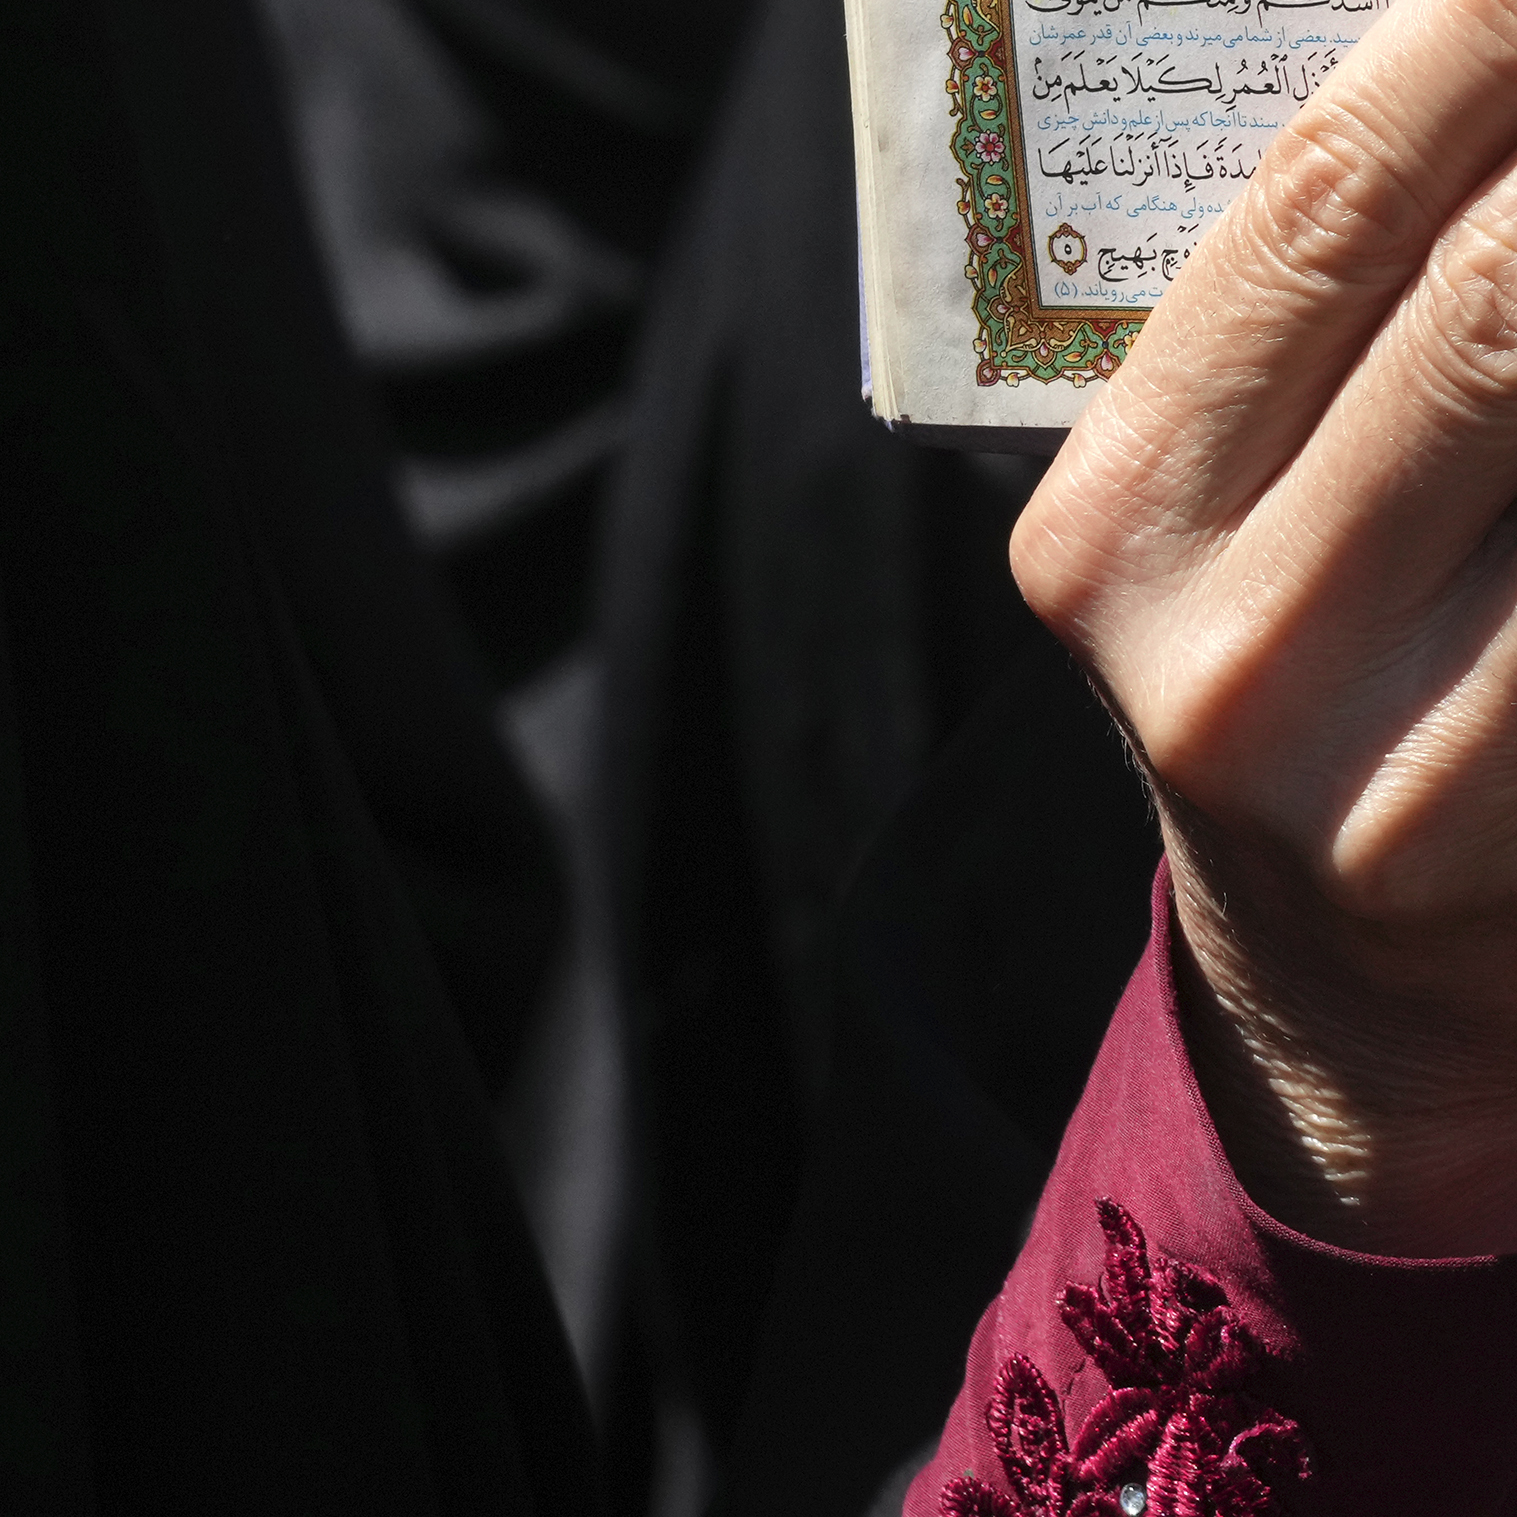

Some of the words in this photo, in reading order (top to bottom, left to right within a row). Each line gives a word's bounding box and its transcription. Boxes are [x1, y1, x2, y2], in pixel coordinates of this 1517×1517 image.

[1045, 195, 1063, 217] آن
[1066, 203, 1079, 217] بر
[1080, 195, 1102, 216] آب
[1105, 195, 1123, 212] که
[1126, 196, 1178, 218] هنگامی
